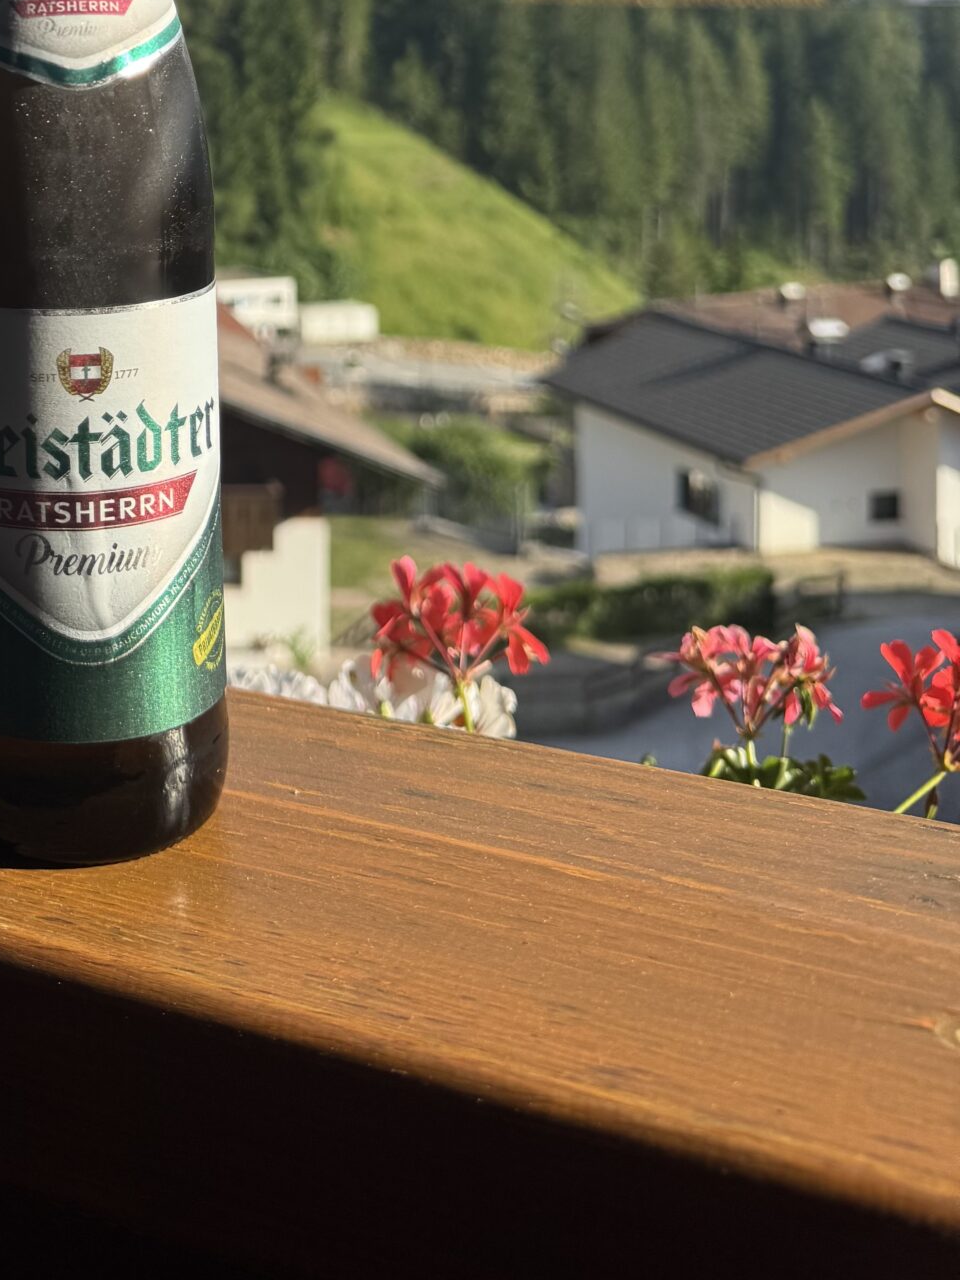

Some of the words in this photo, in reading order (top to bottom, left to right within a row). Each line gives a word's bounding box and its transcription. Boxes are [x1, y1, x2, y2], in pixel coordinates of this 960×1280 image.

[26, 0, 120, 15] RATSHERRN
[30, 373, 57, 383] SEIT
[114, 367, 139, 380] 1777
